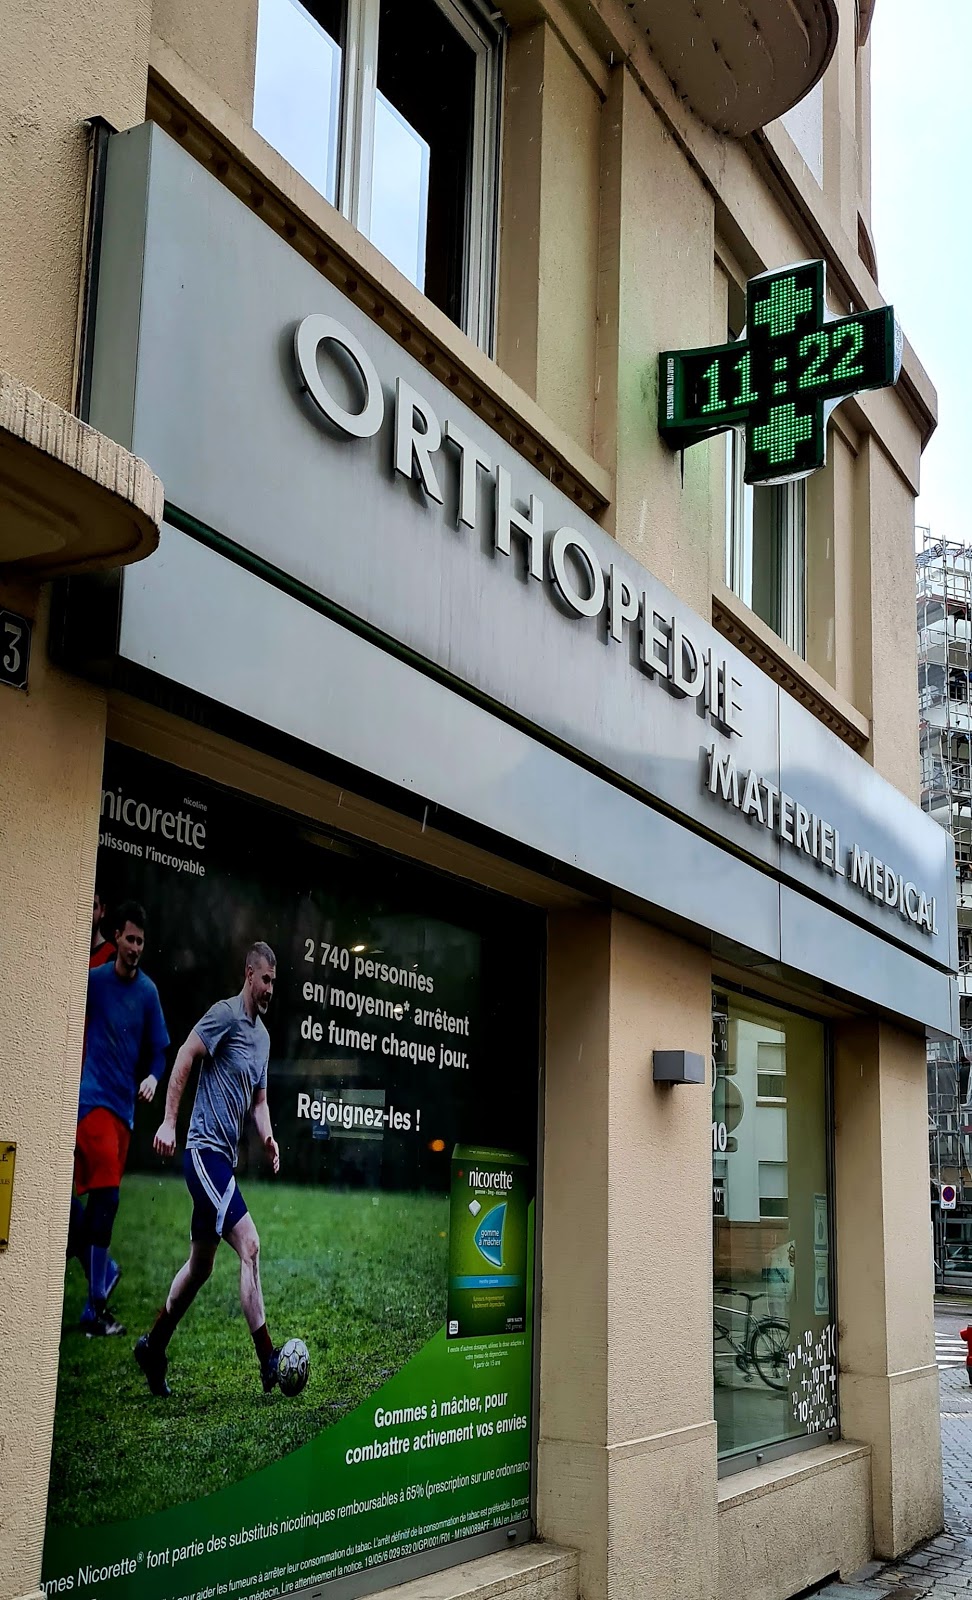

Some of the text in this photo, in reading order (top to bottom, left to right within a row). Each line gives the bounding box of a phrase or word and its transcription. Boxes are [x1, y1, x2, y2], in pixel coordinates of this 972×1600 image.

[702, 322, 864, 413] 11:22
[294, 313, 743, 738] ORTHOPEDIE
[3, 622, 22, 672] 3
[100, 787, 206, 850] nicorette
[183, 797, 208, 812] nicotine
[707, 743, 939, 936] MATERIEL MEDICAL
[145, 846, 206, 877] l'incroyable
[304, 938, 434, 994] 2 740 personnes
[302, 981, 324, 1004] en
[414, 1008, 470, 1036] arrêtent
[301, 1015, 470, 1069] de fumer chaque jour.
[721, 1039, 728, 1052] 10
[297, 1093, 411, 1131] Rejoignez-les
[712, 1121, 727, 1152] 10
[469, 1167, 513, 1190] nicorette
[713, 1188, 721, 1202] 10
[481, 1229, 500, 1240] gomme
[484, 1237, 502, 1247] mâcher
[804, 1330, 813, 1348] 10
[815, 1343, 823, 1360] 10
[788, 1352, 796, 1369] 10
[812, 1366, 820, 1384] 10
[816, 1383, 825, 1404] 10
[374, 1391, 508, 1428] Gommes à mâcher, pour
[798, 1400, 808, 1423] 10
[346, 1414, 527, 1465] combattre activement vos envies
[147, 1550, 169, 1569] font
[172, 1538, 204, 1566] partie
[206, 1534, 226, 1553] des
[229, 1521, 278, 1547] substituts
[280, 1509, 336, 1533] nicotiniques
[337, 1489, 398, 1518] remboursables
[399, 1488, 405, 1502] à
[406, 1484, 425, 1502] 65%
[426, 1472, 469, 1499] (prescription
[470, 1473, 481, 1485] sur
[483, 1469, 495, 1483] une
[496, 1460, 530, 1478] ordonnanc
[217, 1583, 228, 1595] les
[228, 1574, 258, 1592] fumeurs
[258, 1571, 263, 1583] à
[263, 1566, 286, 1582] arrêter
[286, 1562, 299, 1575] leur
[299, 1548, 345, 1570] consommation
[346, 1544, 354, 1557] du
[355, 1541, 373, 1554] tabac.
[411, 1527, 417, 1538] de
[418, 1525, 423, 1535] la
[423, 1515, 459, 1533] consommation
[460, 1512, 466, 1522] de
[466, 1510, 480, 1521] tabac
[281, 1581, 294, 1594] Lire
[294, 1567, 337, 1590] attentivement
[337, 1564, 343, 1576] la
